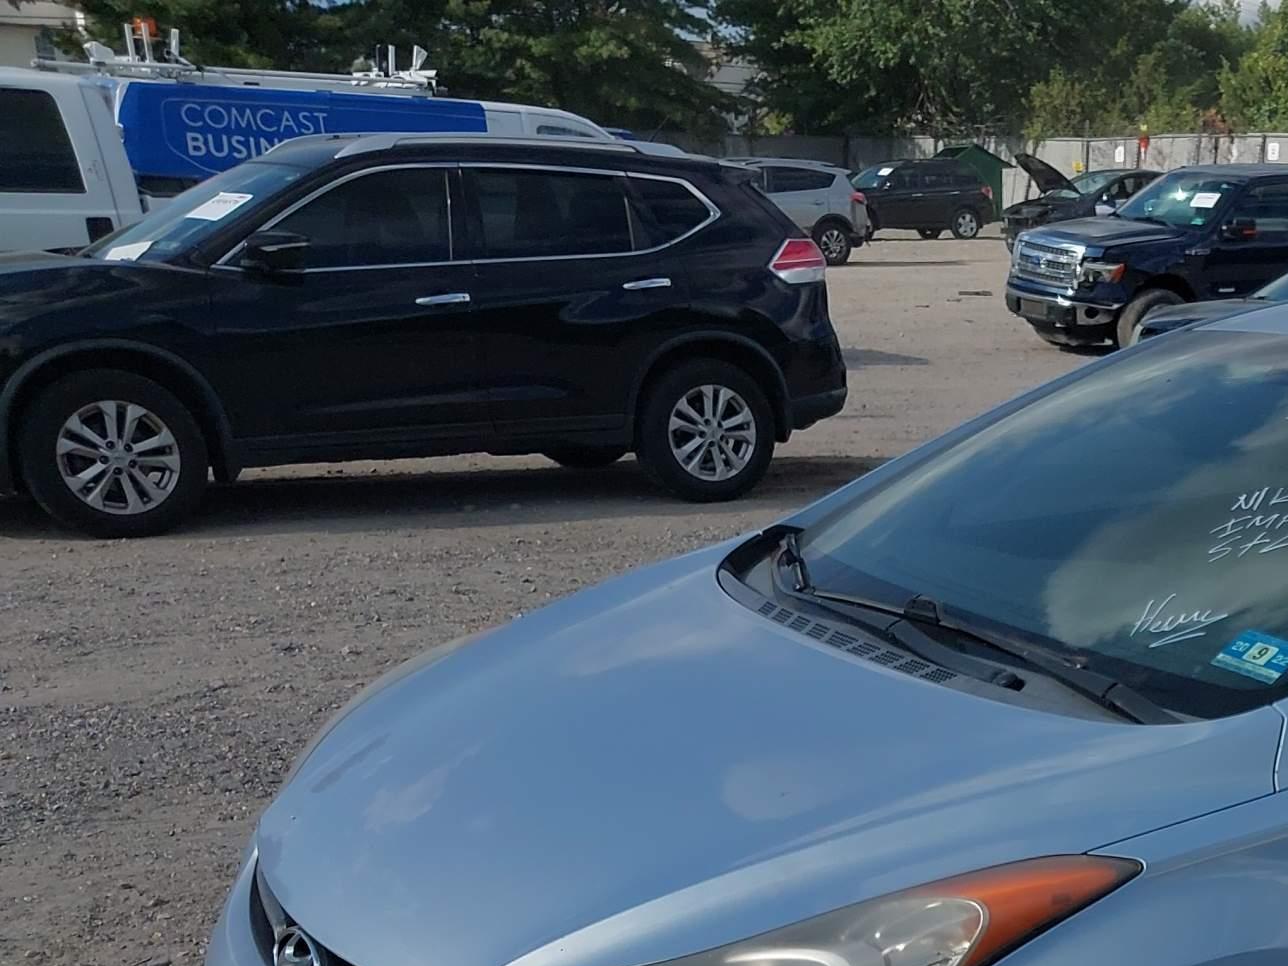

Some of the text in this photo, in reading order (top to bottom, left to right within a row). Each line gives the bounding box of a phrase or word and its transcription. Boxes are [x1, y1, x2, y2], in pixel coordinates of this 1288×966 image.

[181, 103, 328, 134] COMCAST
[1231, 640, 1250, 652] 20
[1253, 646, 1269, 661] 9
